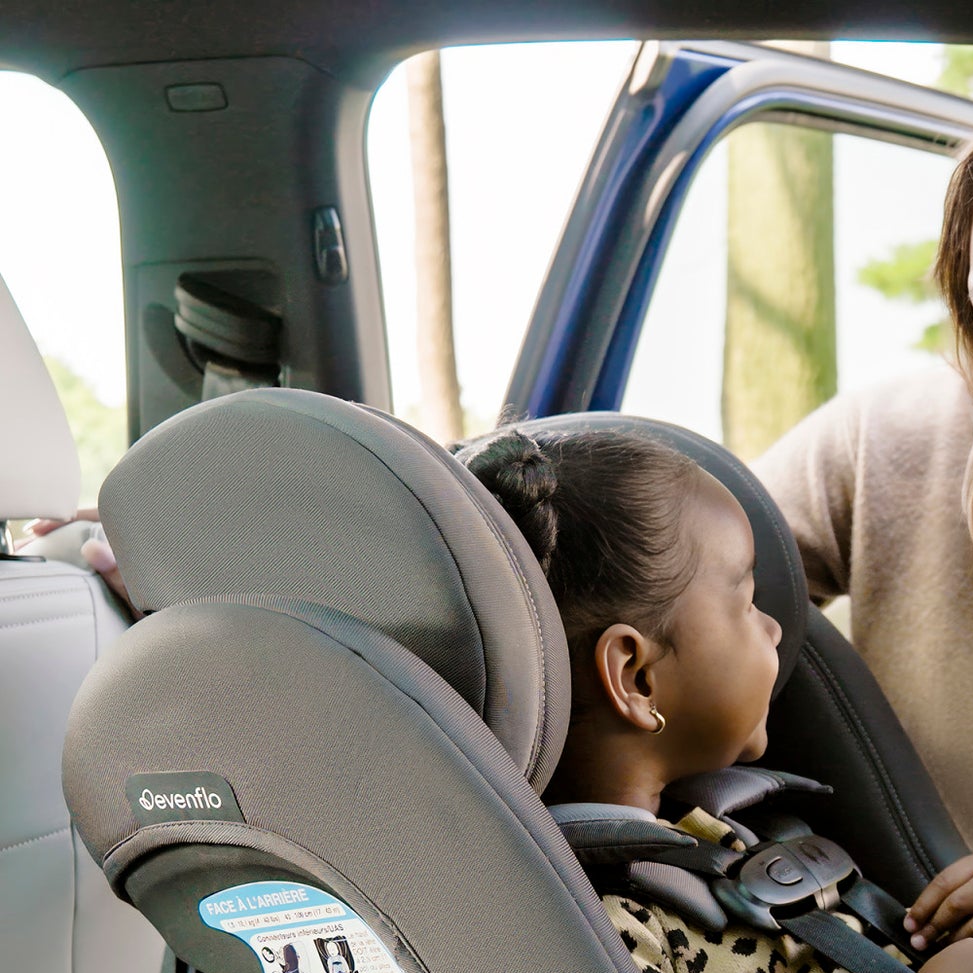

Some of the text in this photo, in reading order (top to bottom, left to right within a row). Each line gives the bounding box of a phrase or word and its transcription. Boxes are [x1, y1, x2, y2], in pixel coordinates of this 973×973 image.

[154, 787, 222, 809] evenflo
[206, 888, 310, 916] FACE À L'ARRIÈRE
